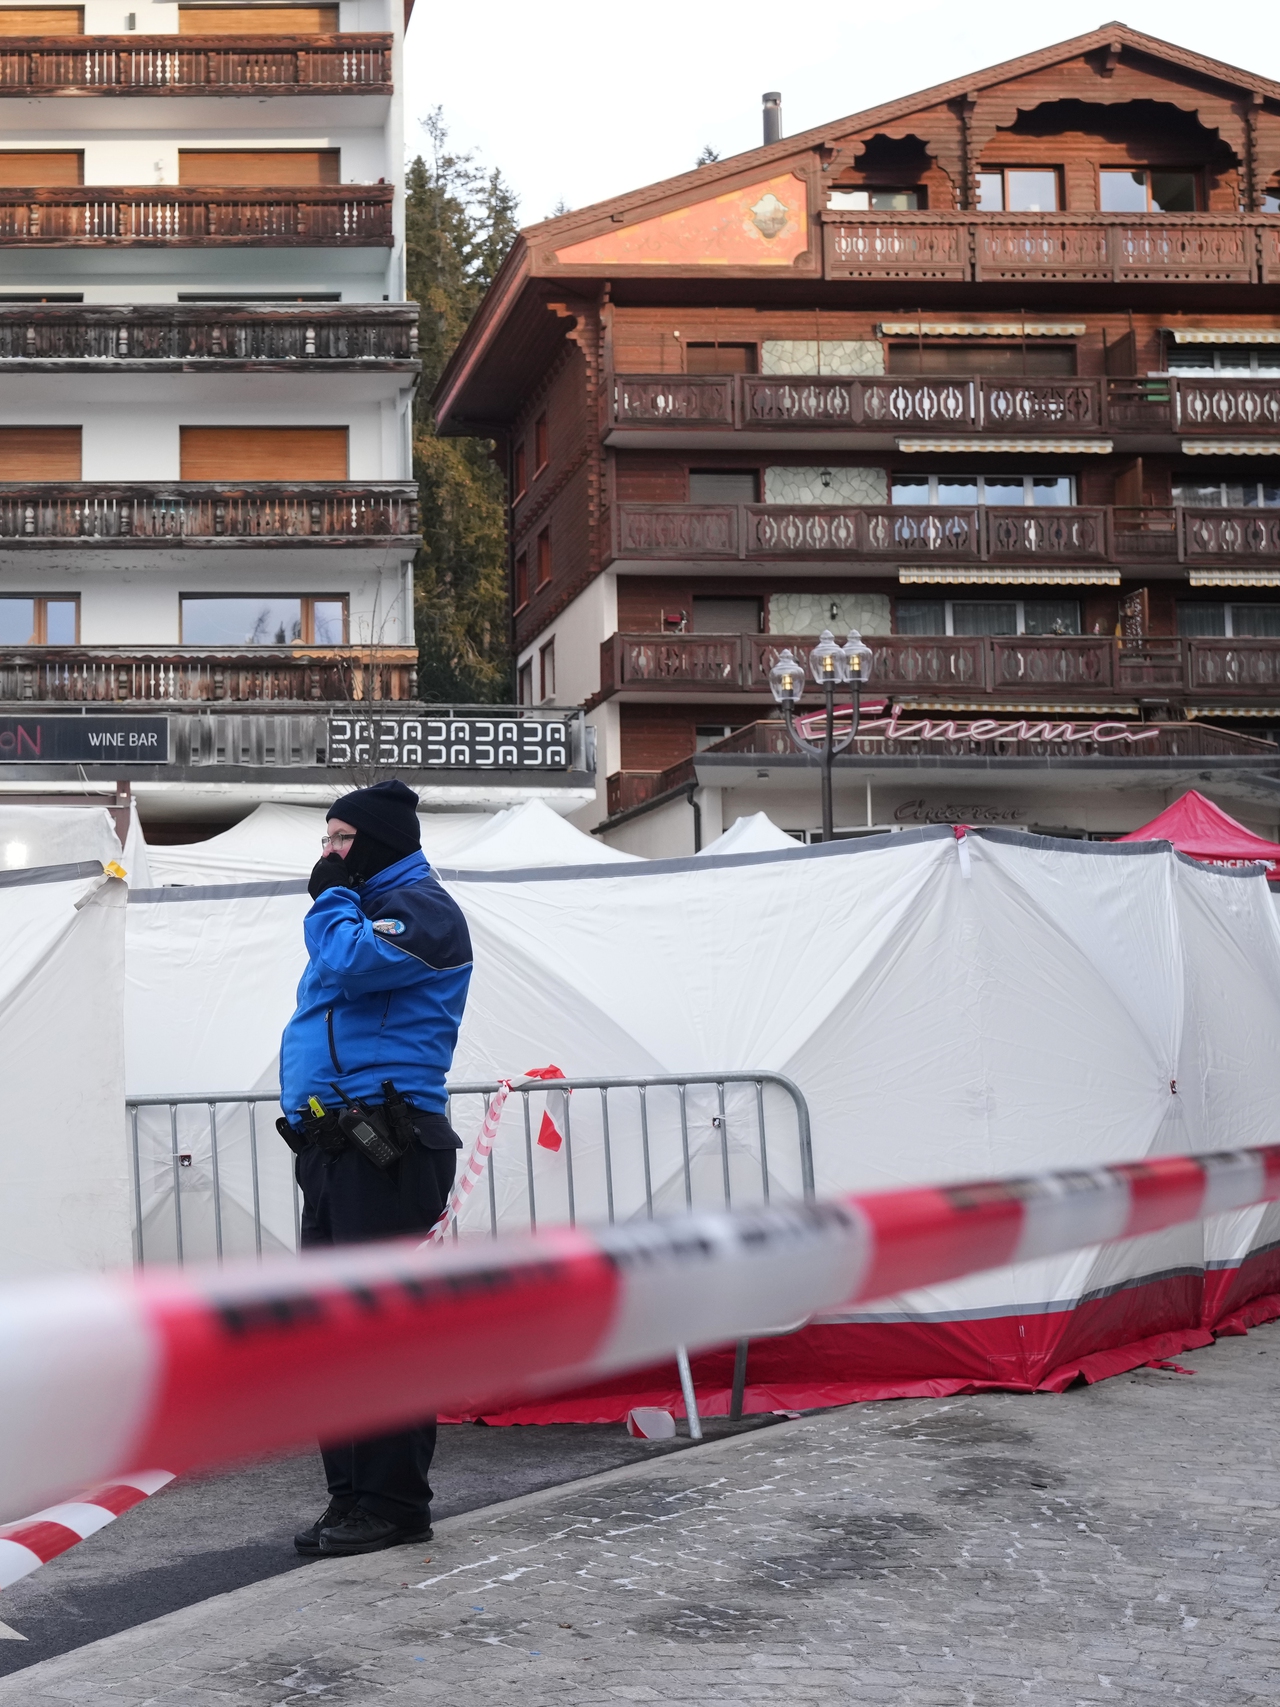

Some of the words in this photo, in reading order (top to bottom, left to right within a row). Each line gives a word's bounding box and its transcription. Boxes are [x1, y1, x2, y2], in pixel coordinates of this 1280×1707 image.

[795, 699, 1160, 743] Cinema
[88, 732, 125, 747] WINE
[129, 732, 158, 747] BAR
